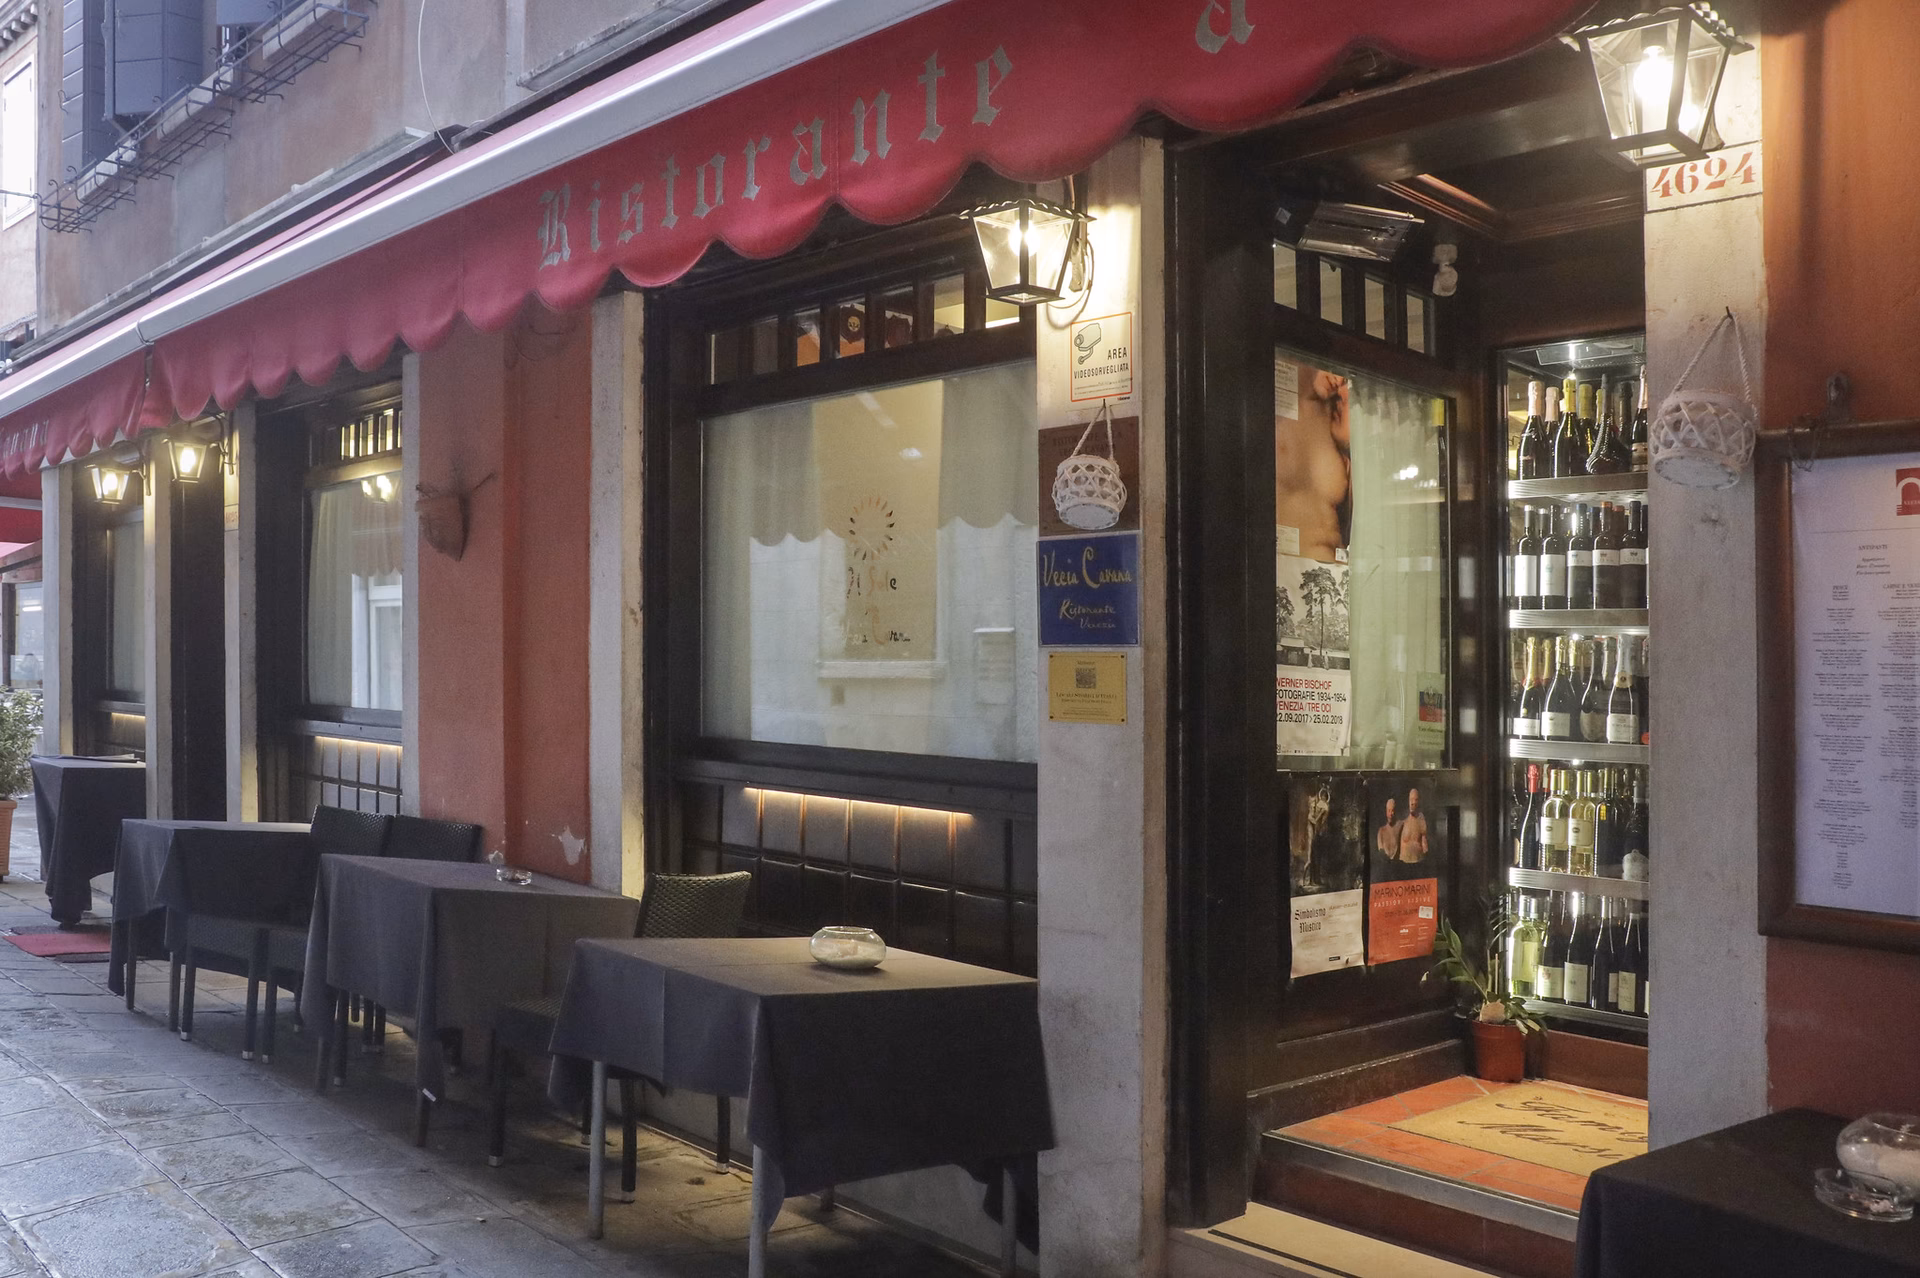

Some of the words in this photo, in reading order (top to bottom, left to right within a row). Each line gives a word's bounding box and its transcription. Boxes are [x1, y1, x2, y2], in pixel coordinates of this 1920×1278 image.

[537, 43, 1014, 271] Ristorante
[1649, 151, 1757, 198] 4624
[1107, 347, 1127, 360] AREA
[1074, 363, 1129, 379] VIDEOSORVEGLIATA
[1059, 599, 1116, 619] Ristorante
[1305, 680, 1332, 690] BISCHOF
[1317, 692, 1347, 702] 1934-1954
[1321, 703, 1332, 712] OCI
